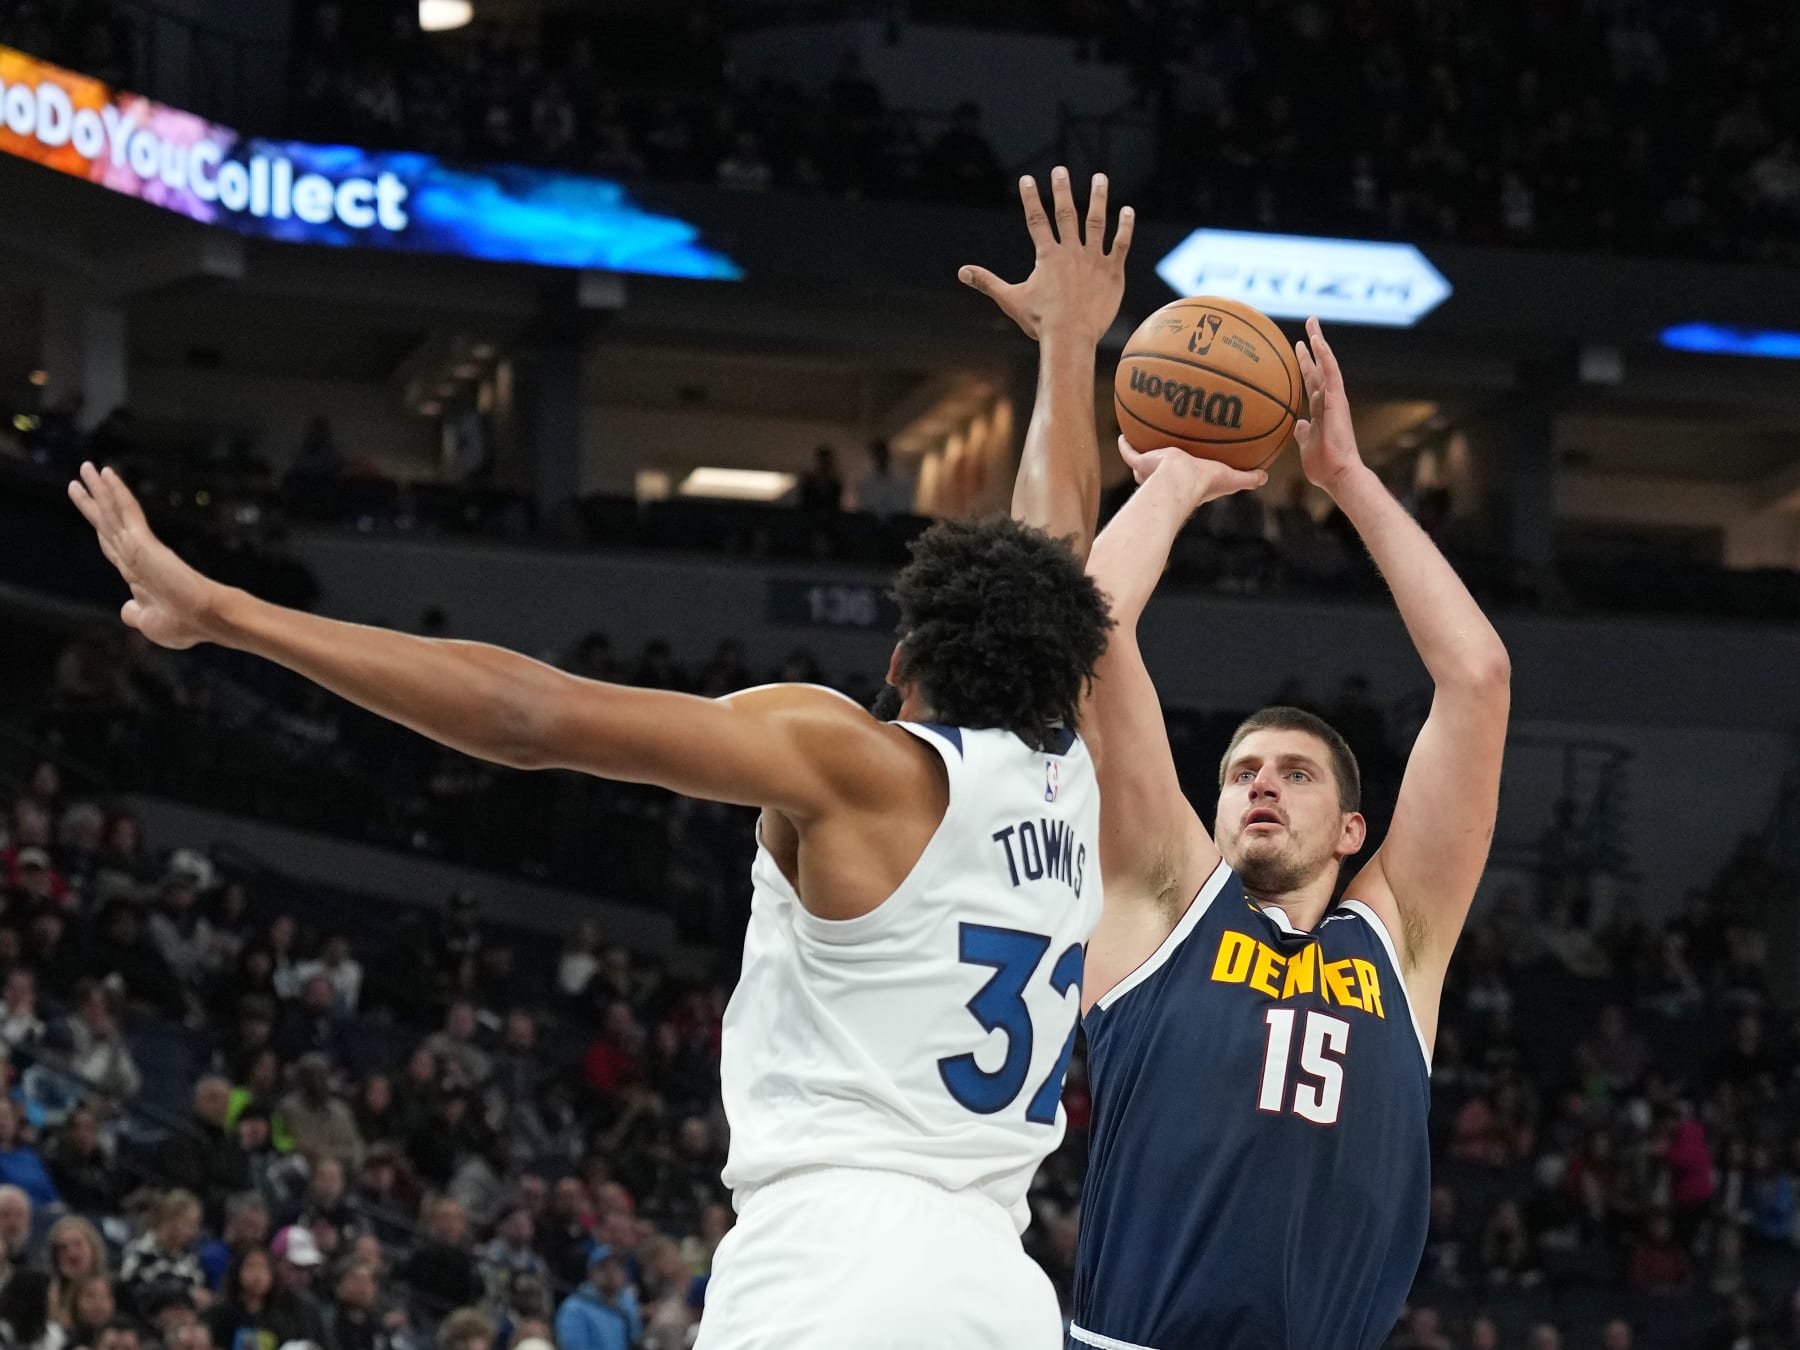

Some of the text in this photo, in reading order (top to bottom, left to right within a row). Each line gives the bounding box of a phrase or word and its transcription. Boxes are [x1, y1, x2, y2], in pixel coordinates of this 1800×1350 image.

[0, 80, 409, 231] oDoYouCollect
[1129, 365, 1243, 430] Wilson
[992, 818, 1086, 899] TOWNS
[1256, 1007, 1351, 1126] 15
